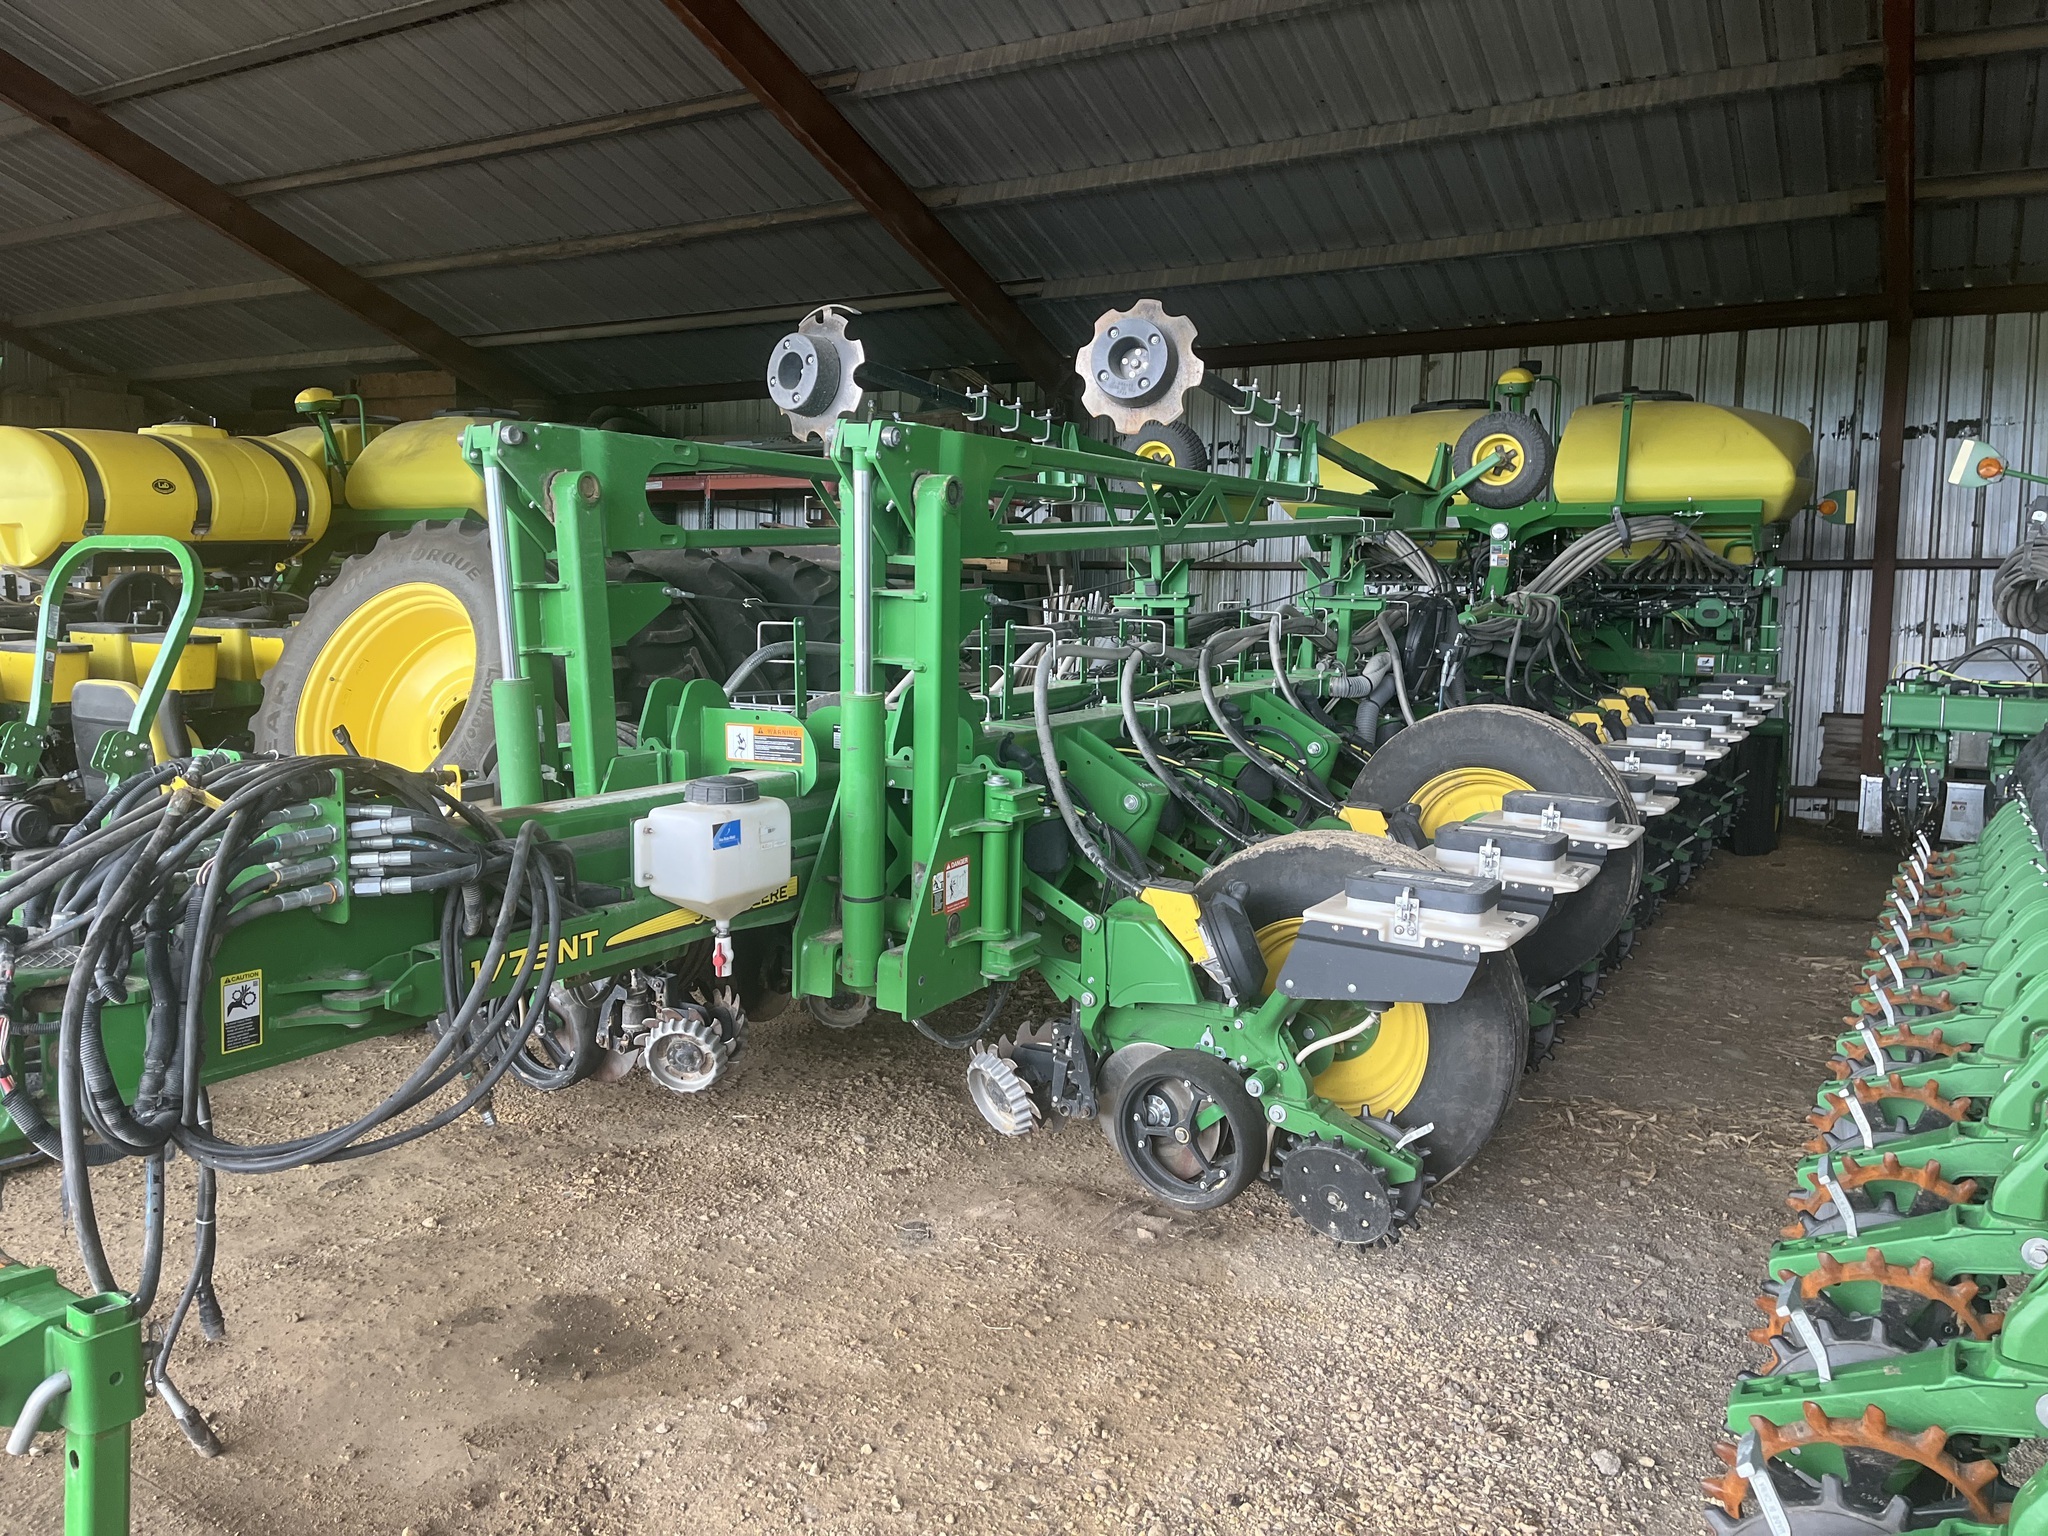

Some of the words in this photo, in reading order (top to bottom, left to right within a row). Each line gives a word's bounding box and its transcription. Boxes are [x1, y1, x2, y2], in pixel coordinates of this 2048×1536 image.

[767, 729, 798, 737] WARNING
[951, 857, 968, 867] DANGER
[231, 972, 259, 982] CAUTION
